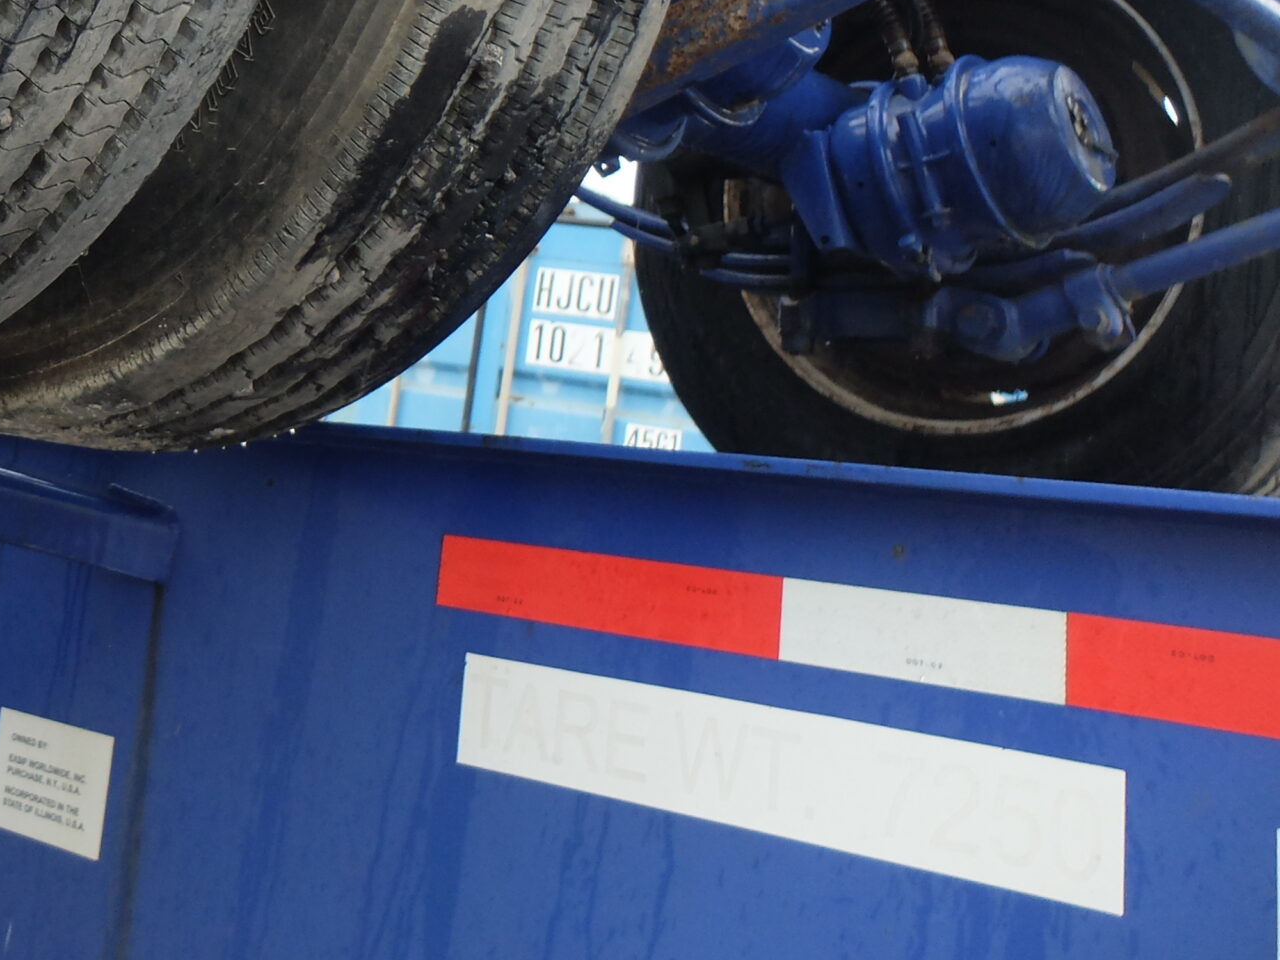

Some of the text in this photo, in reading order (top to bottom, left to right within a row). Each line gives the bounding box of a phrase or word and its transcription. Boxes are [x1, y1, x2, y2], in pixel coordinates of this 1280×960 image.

[535, 271, 616, 315] HJCU
[11, 732, 36, 748] OWNED
[6, 765, 45, 785] PURCHASE,
[62, 783, 82, 796] U.S.A.
[469, 671, 1106, 884] TARE WT. 7250
[2, 797, 23, 812] STATE
[23, 804, 34, 814] OF
[65, 818, 86, 833] U.S.A.
[4, 785, 80, 817] INCORPORATED IN THE
